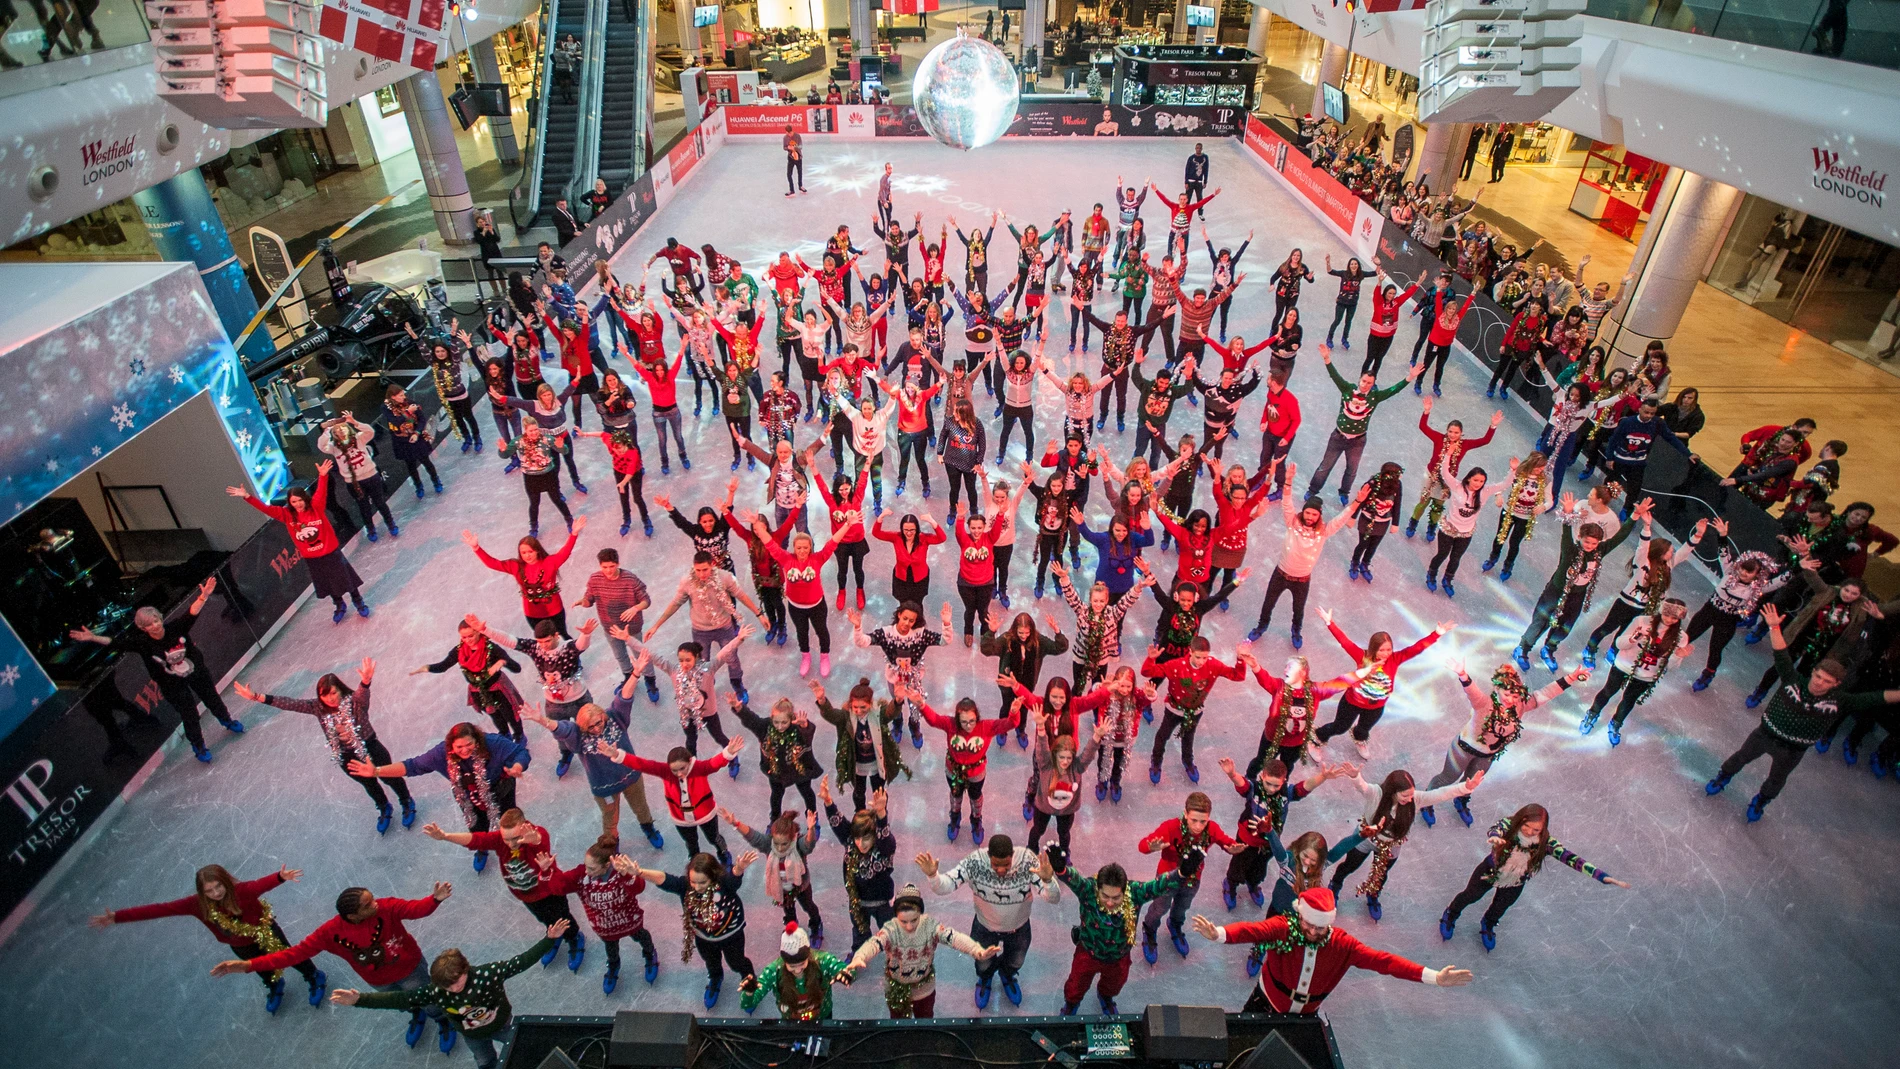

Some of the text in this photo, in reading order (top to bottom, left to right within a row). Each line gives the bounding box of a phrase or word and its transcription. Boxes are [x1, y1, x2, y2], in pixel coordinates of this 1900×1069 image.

[349, 5, 371, 17] HUAWEI
[406, 26, 428, 37] HUAWEI
[371, 61, 392, 75] LONDON
[758, 114, 789, 122] Ascend
[790, 114, 803, 122] P6
[80, 134, 136, 170] Westfield
[83, 157, 134, 186] LONDON
[1811, 147, 1889, 191] Westfield
[1813, 175, 1882, 208] LONDON
[1325, 193, 1354, 223] SMARTPHONE
[8, 785, 92, 864] TRESOR
[45, 816, 77, 849] PARIS
[590, 888, 619, 902] MERRY
[602, 909, 614, 919] YA
